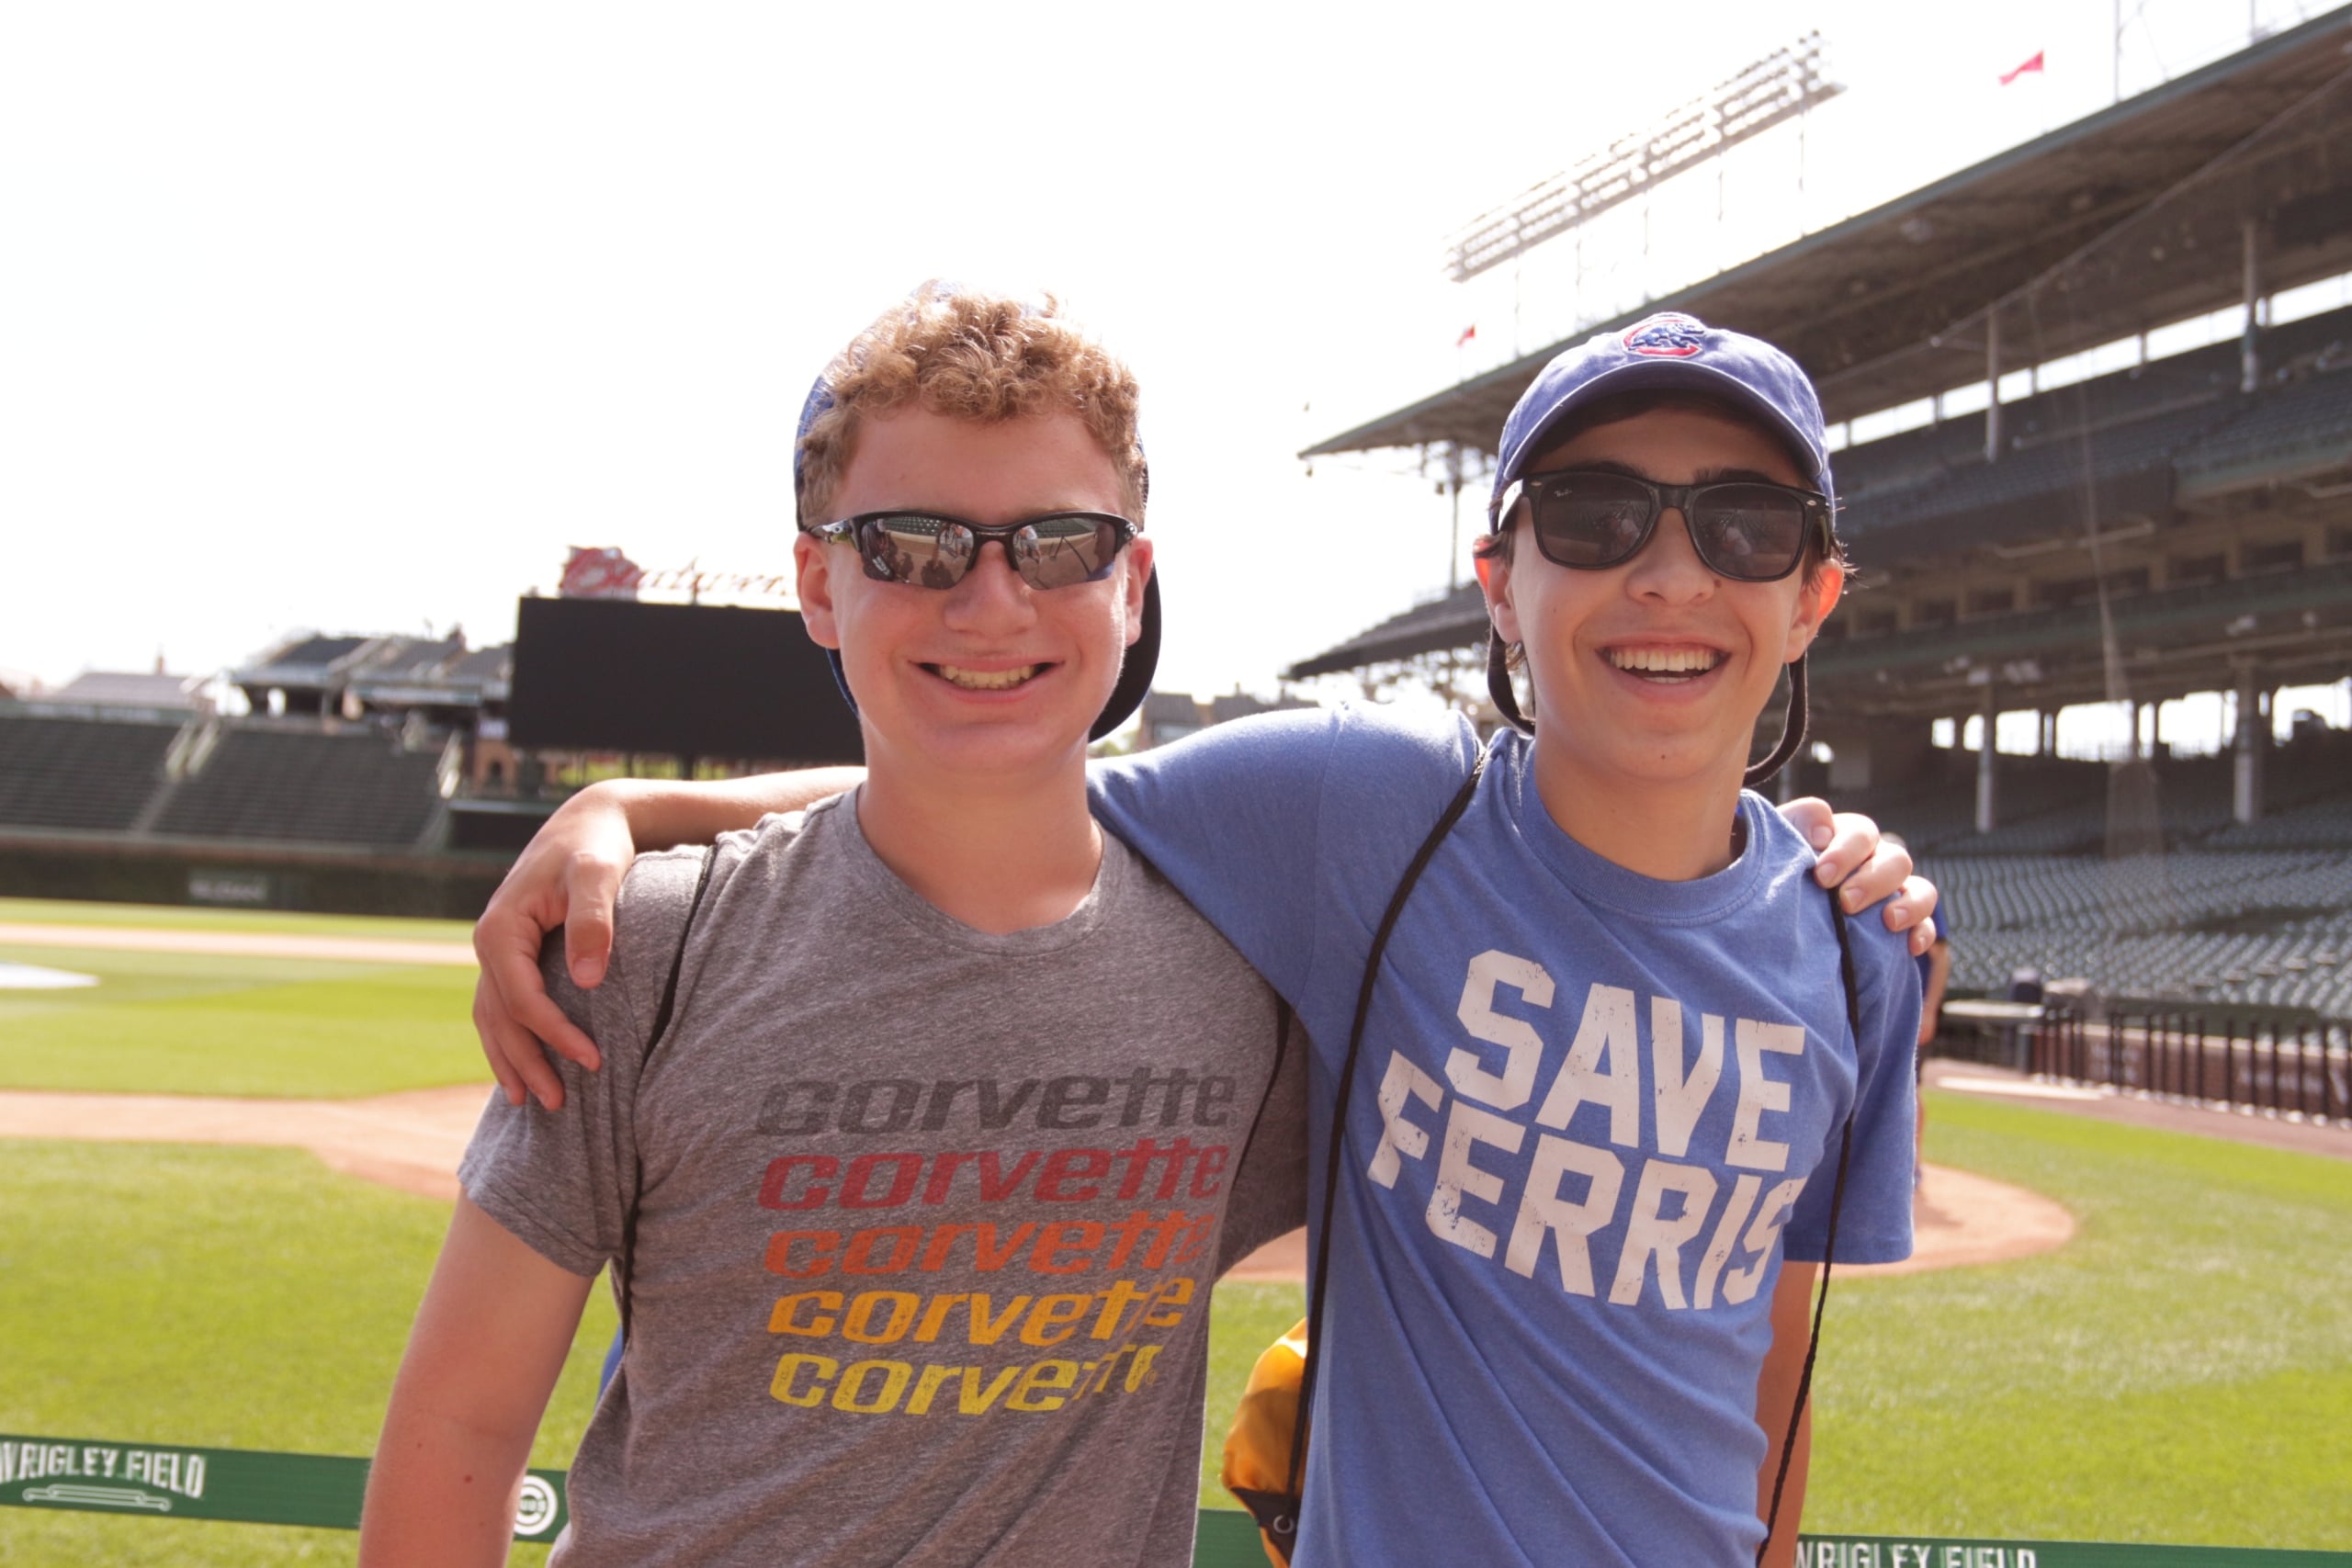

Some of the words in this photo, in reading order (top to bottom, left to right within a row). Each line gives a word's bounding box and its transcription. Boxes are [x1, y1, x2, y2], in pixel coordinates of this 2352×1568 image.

[1444, 949, 1805, 1171] SAVE
[756, 1066, 1237, 1136] corvette
[757, 1137, 1230, 1211] corvette
[1366, 1049, 1808, 1310] FERRIS
[764, 1210, 1215, 1278] corvette
[0, 1441, 119, 1483] WRIGLEY
[126, 1450, 206, 1499] FIELD
